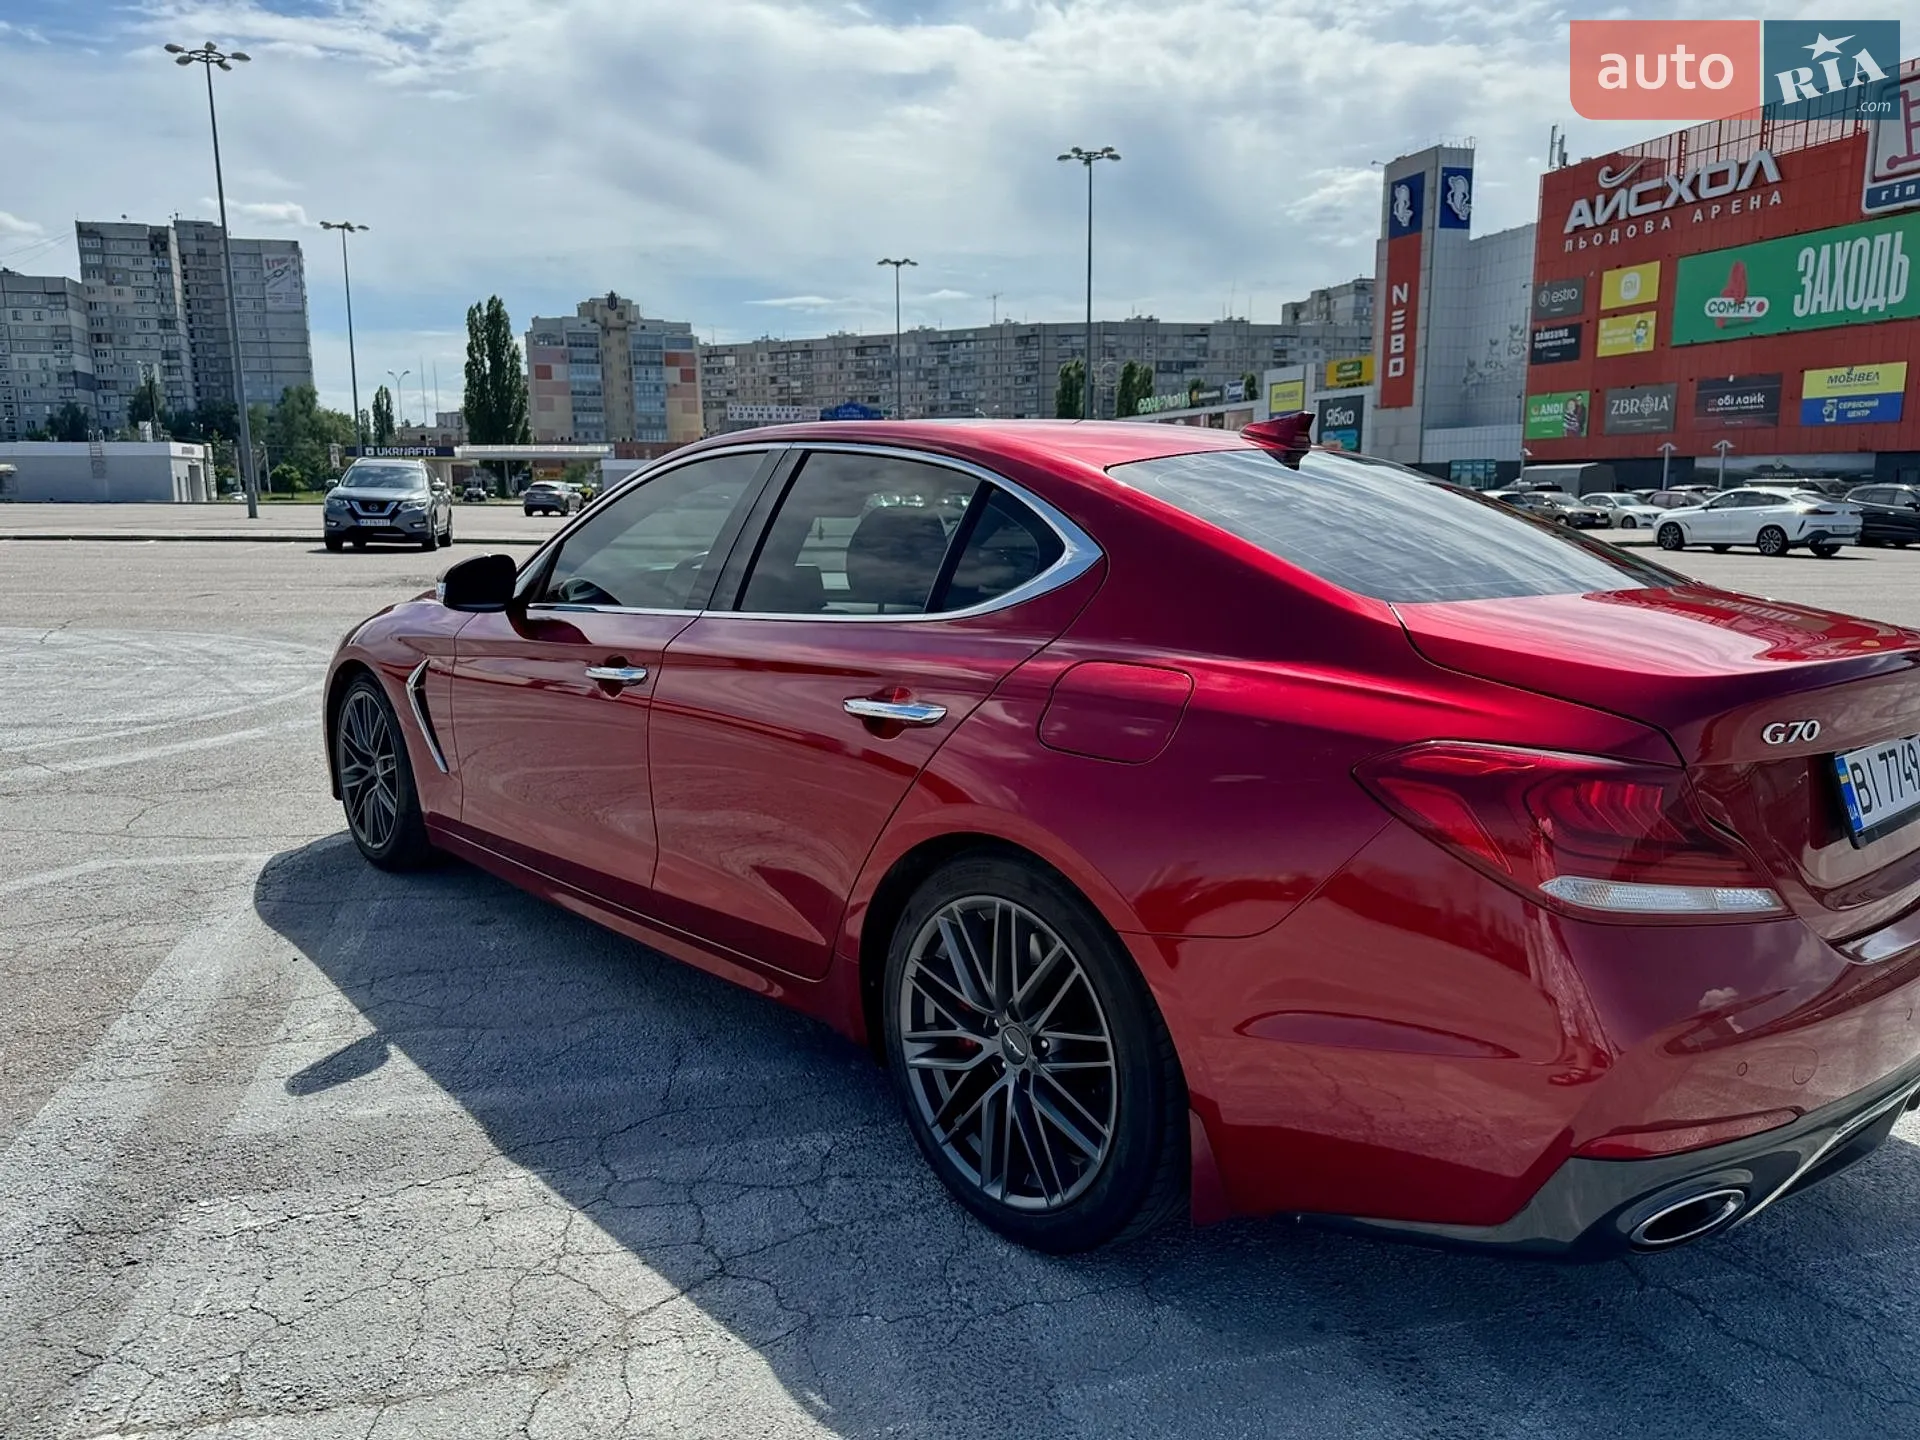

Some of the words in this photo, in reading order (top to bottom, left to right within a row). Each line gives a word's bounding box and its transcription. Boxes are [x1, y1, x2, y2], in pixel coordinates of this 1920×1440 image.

[1564, 215, 1672, 254] ЛЬОДОВА
[1692, 190, 1783, 223] АРЕНА
[1793, 230, 1911, 318] ЗАХОДЬ
[1707, 300, 1757, 316] COMFY
[1387, 282, 1409, 378] NEBO
[1535, 329, 1569, 341] SAMSUNG
[1325, 407, 1355, 427] Ябко
[1762, 719, 1821, 745] G70
[1850, 758, 1882, 814] BI
